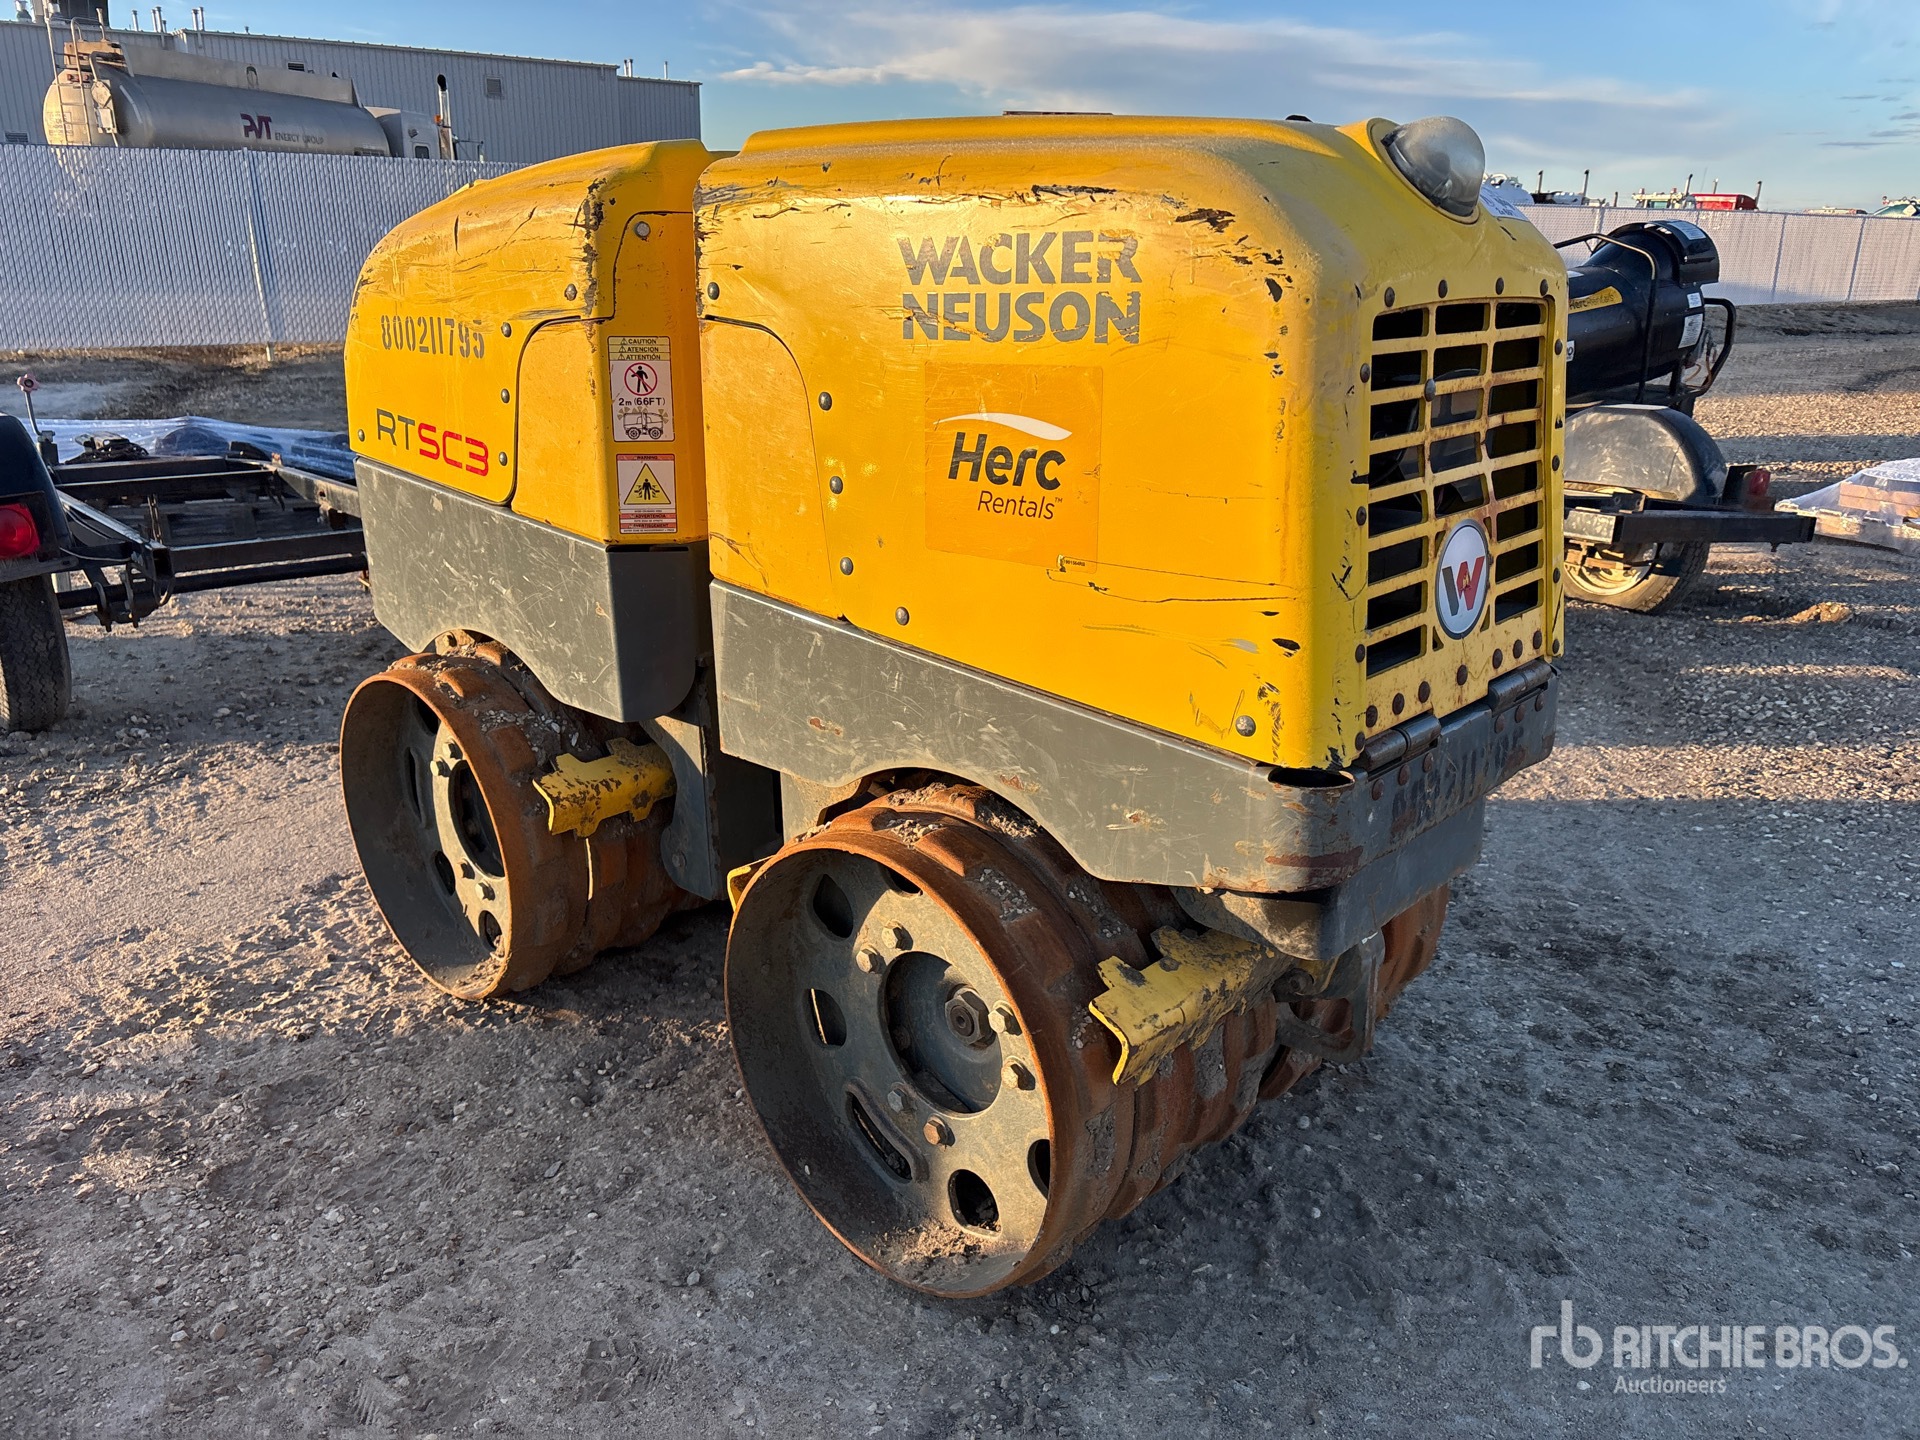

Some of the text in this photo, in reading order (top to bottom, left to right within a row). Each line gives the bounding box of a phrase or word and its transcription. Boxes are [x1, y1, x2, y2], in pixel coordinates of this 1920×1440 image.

[240, 113, 272, 139] PVT
[275, 132, 300, 143] ENERGY
[896, 230, 1143, 285] WACKER
[380, 314, 485, 359] 800211795
[902, 290, 1141, 344] NEUSON
[948, 431, 1066, 491] Herc
